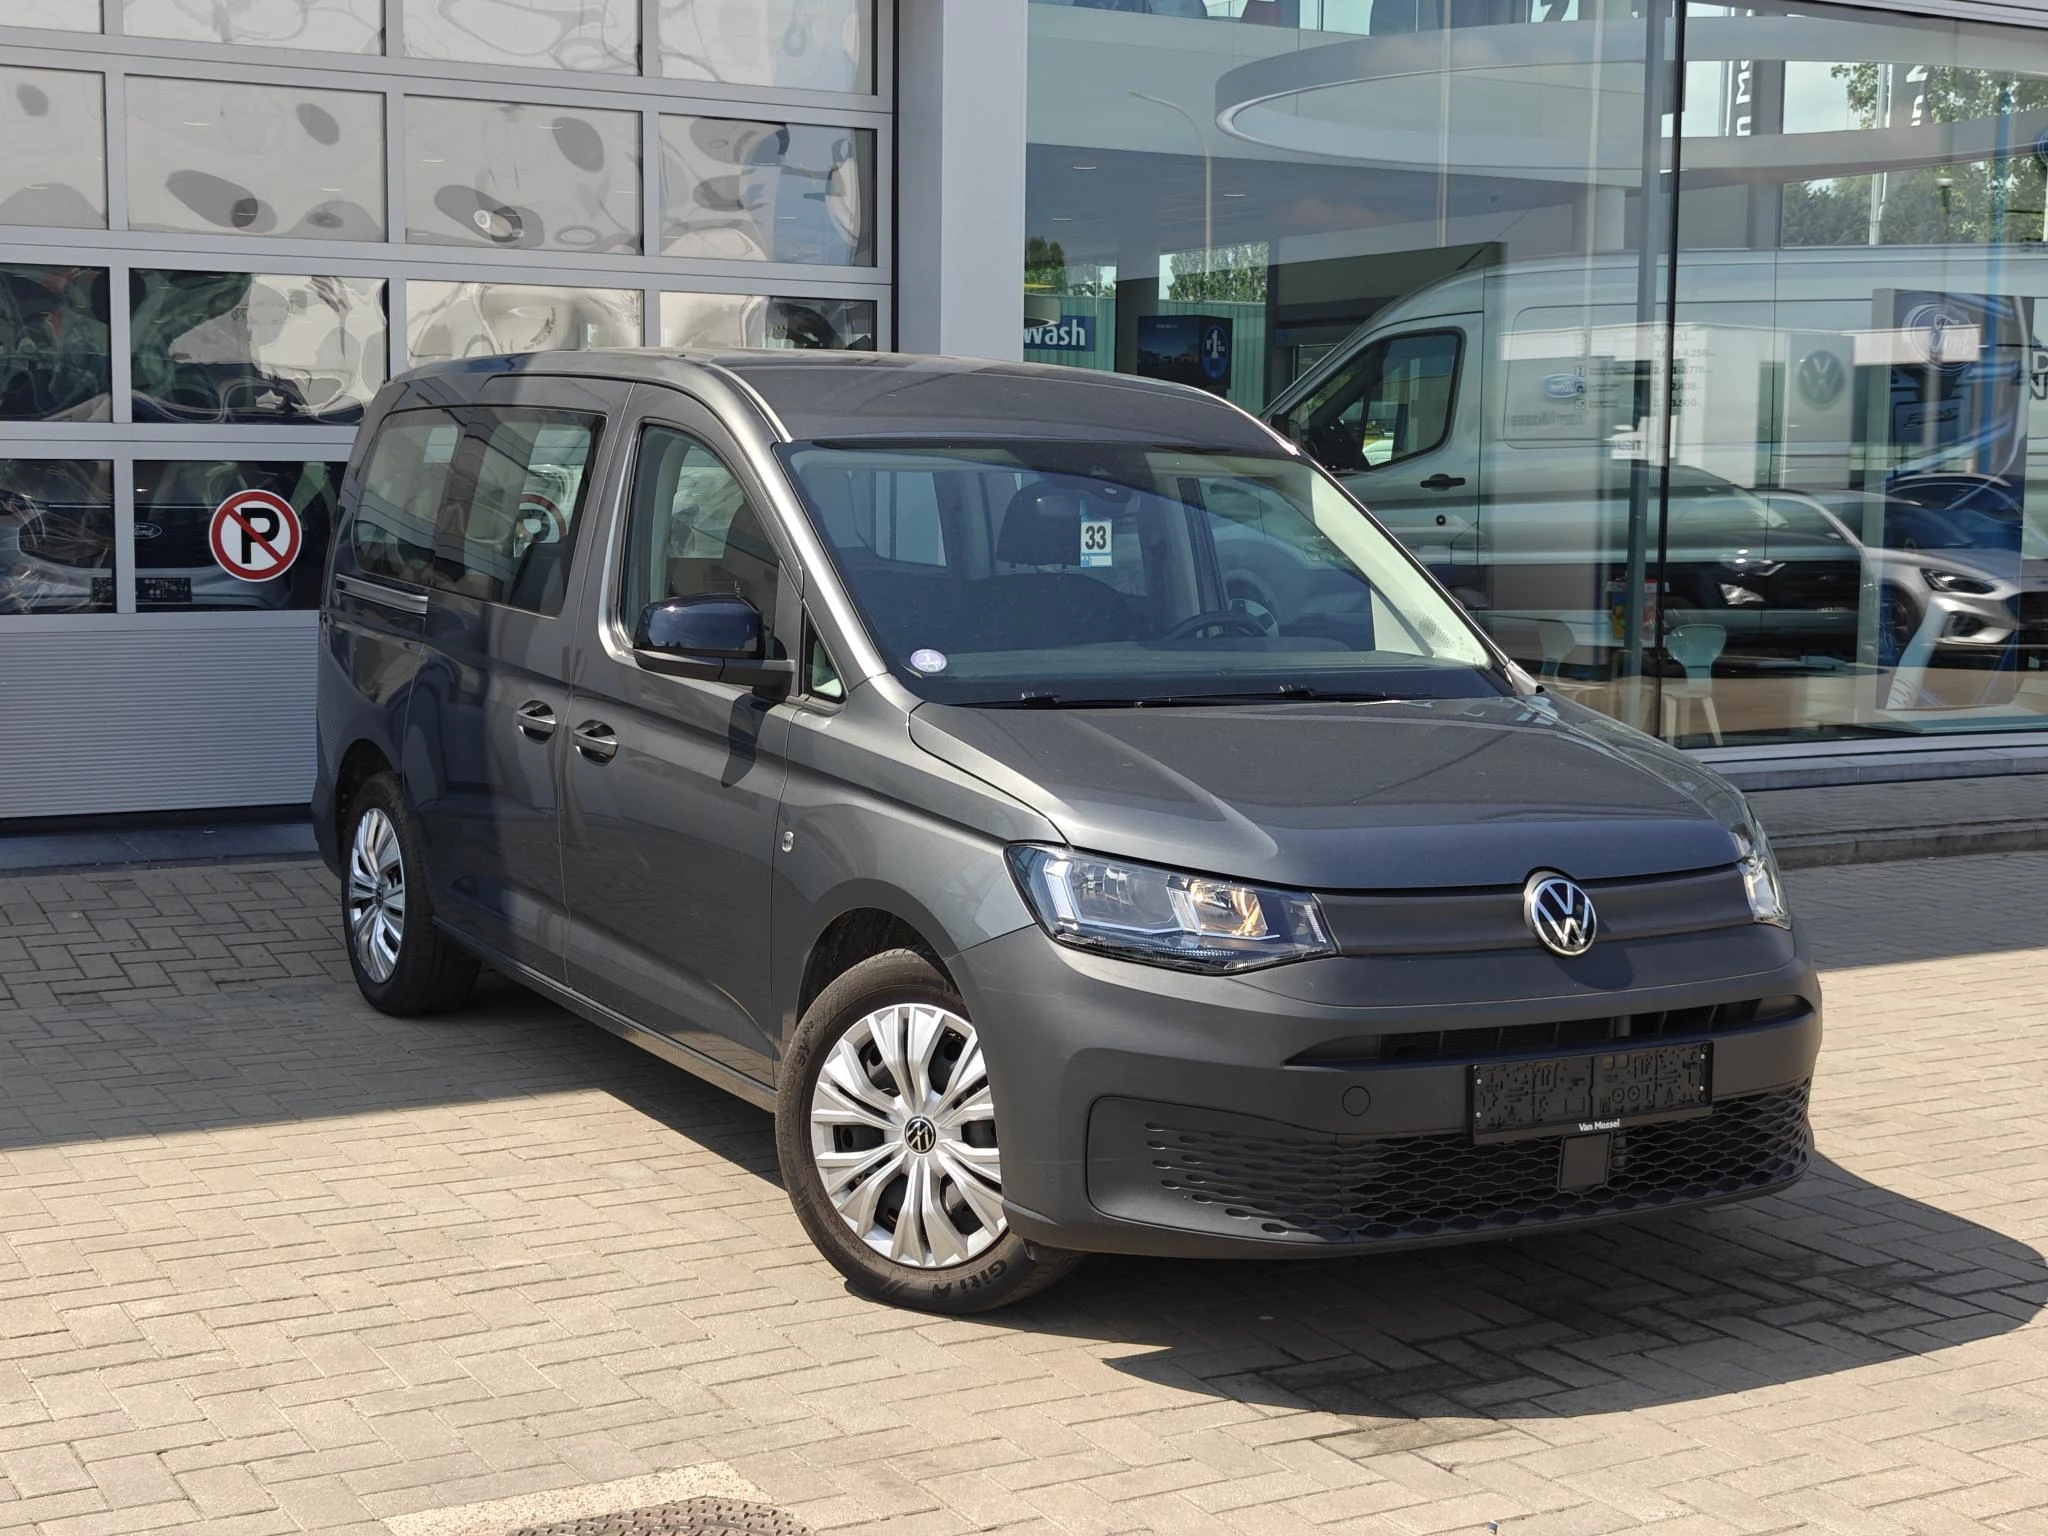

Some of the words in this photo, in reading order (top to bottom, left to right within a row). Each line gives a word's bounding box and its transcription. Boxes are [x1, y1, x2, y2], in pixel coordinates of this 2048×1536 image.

[1085, 525, 1107, 550] 33
[1579, 1122, 1593, 1132] Van
[1594, 1118, 1620, 1130] Mossel
